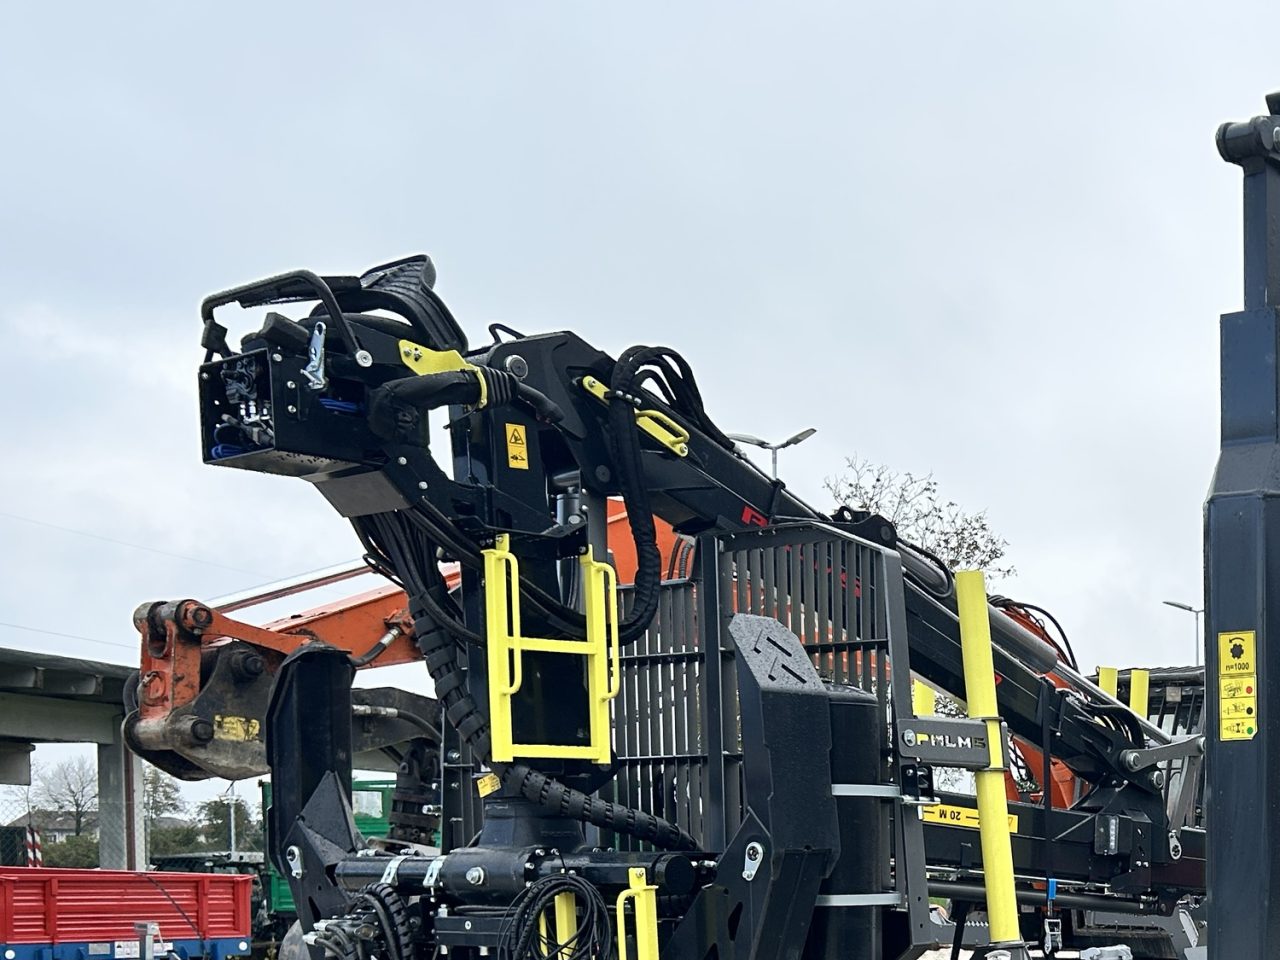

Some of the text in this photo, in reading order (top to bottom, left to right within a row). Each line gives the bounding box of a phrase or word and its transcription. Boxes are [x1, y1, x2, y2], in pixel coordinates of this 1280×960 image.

[1225, 662, 1250, 671] n=1000
[939, 808, 961, 821] 20 M
